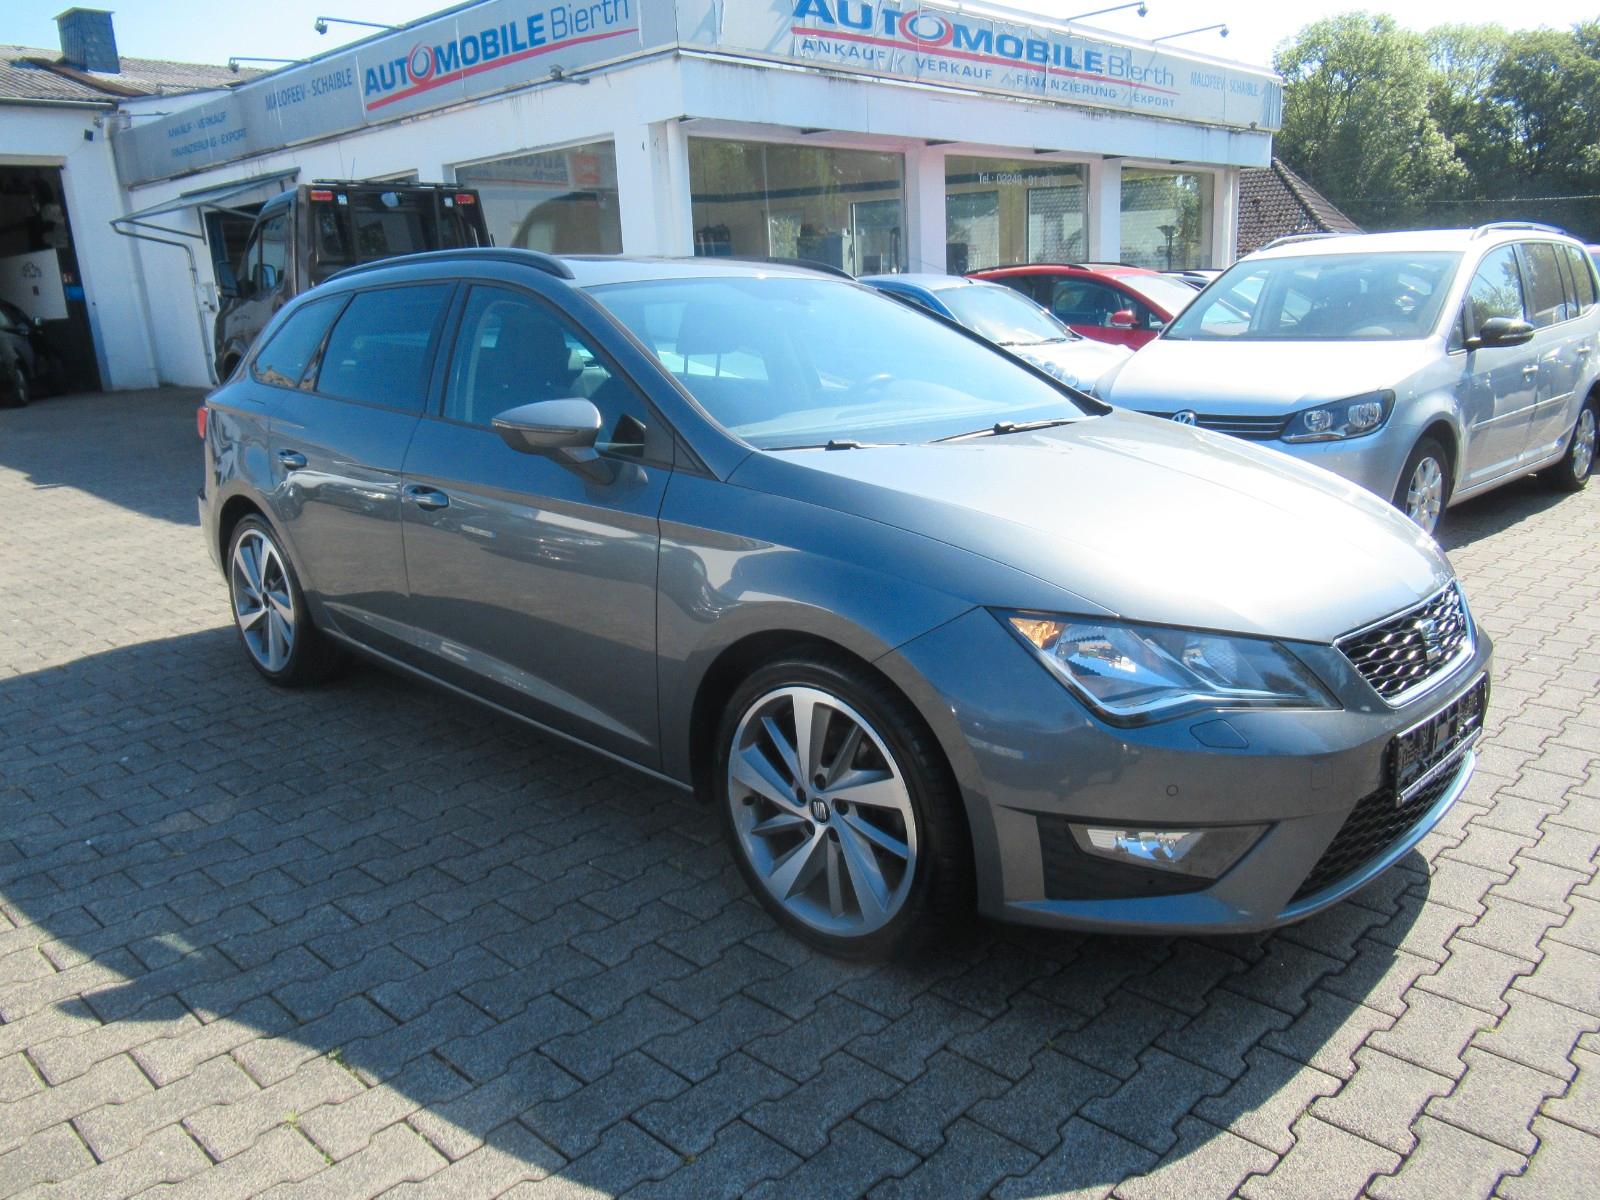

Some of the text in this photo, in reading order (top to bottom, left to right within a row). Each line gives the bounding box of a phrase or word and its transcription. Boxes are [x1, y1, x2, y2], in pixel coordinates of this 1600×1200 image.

[364, 0, 630, 96] AUTOMOBILE Bierth
[802, 39, 886, 62] ANKAUF
[915, 56, 993, 80] VERKAUF
[1016, 73, 1117, 99] FINANZIERUNG
[1133, 92, 1176, 108] EXPORT
[1108, 54, 1174, 87] Bierth
[311, 67, 353, 97] SCHAIBLE
